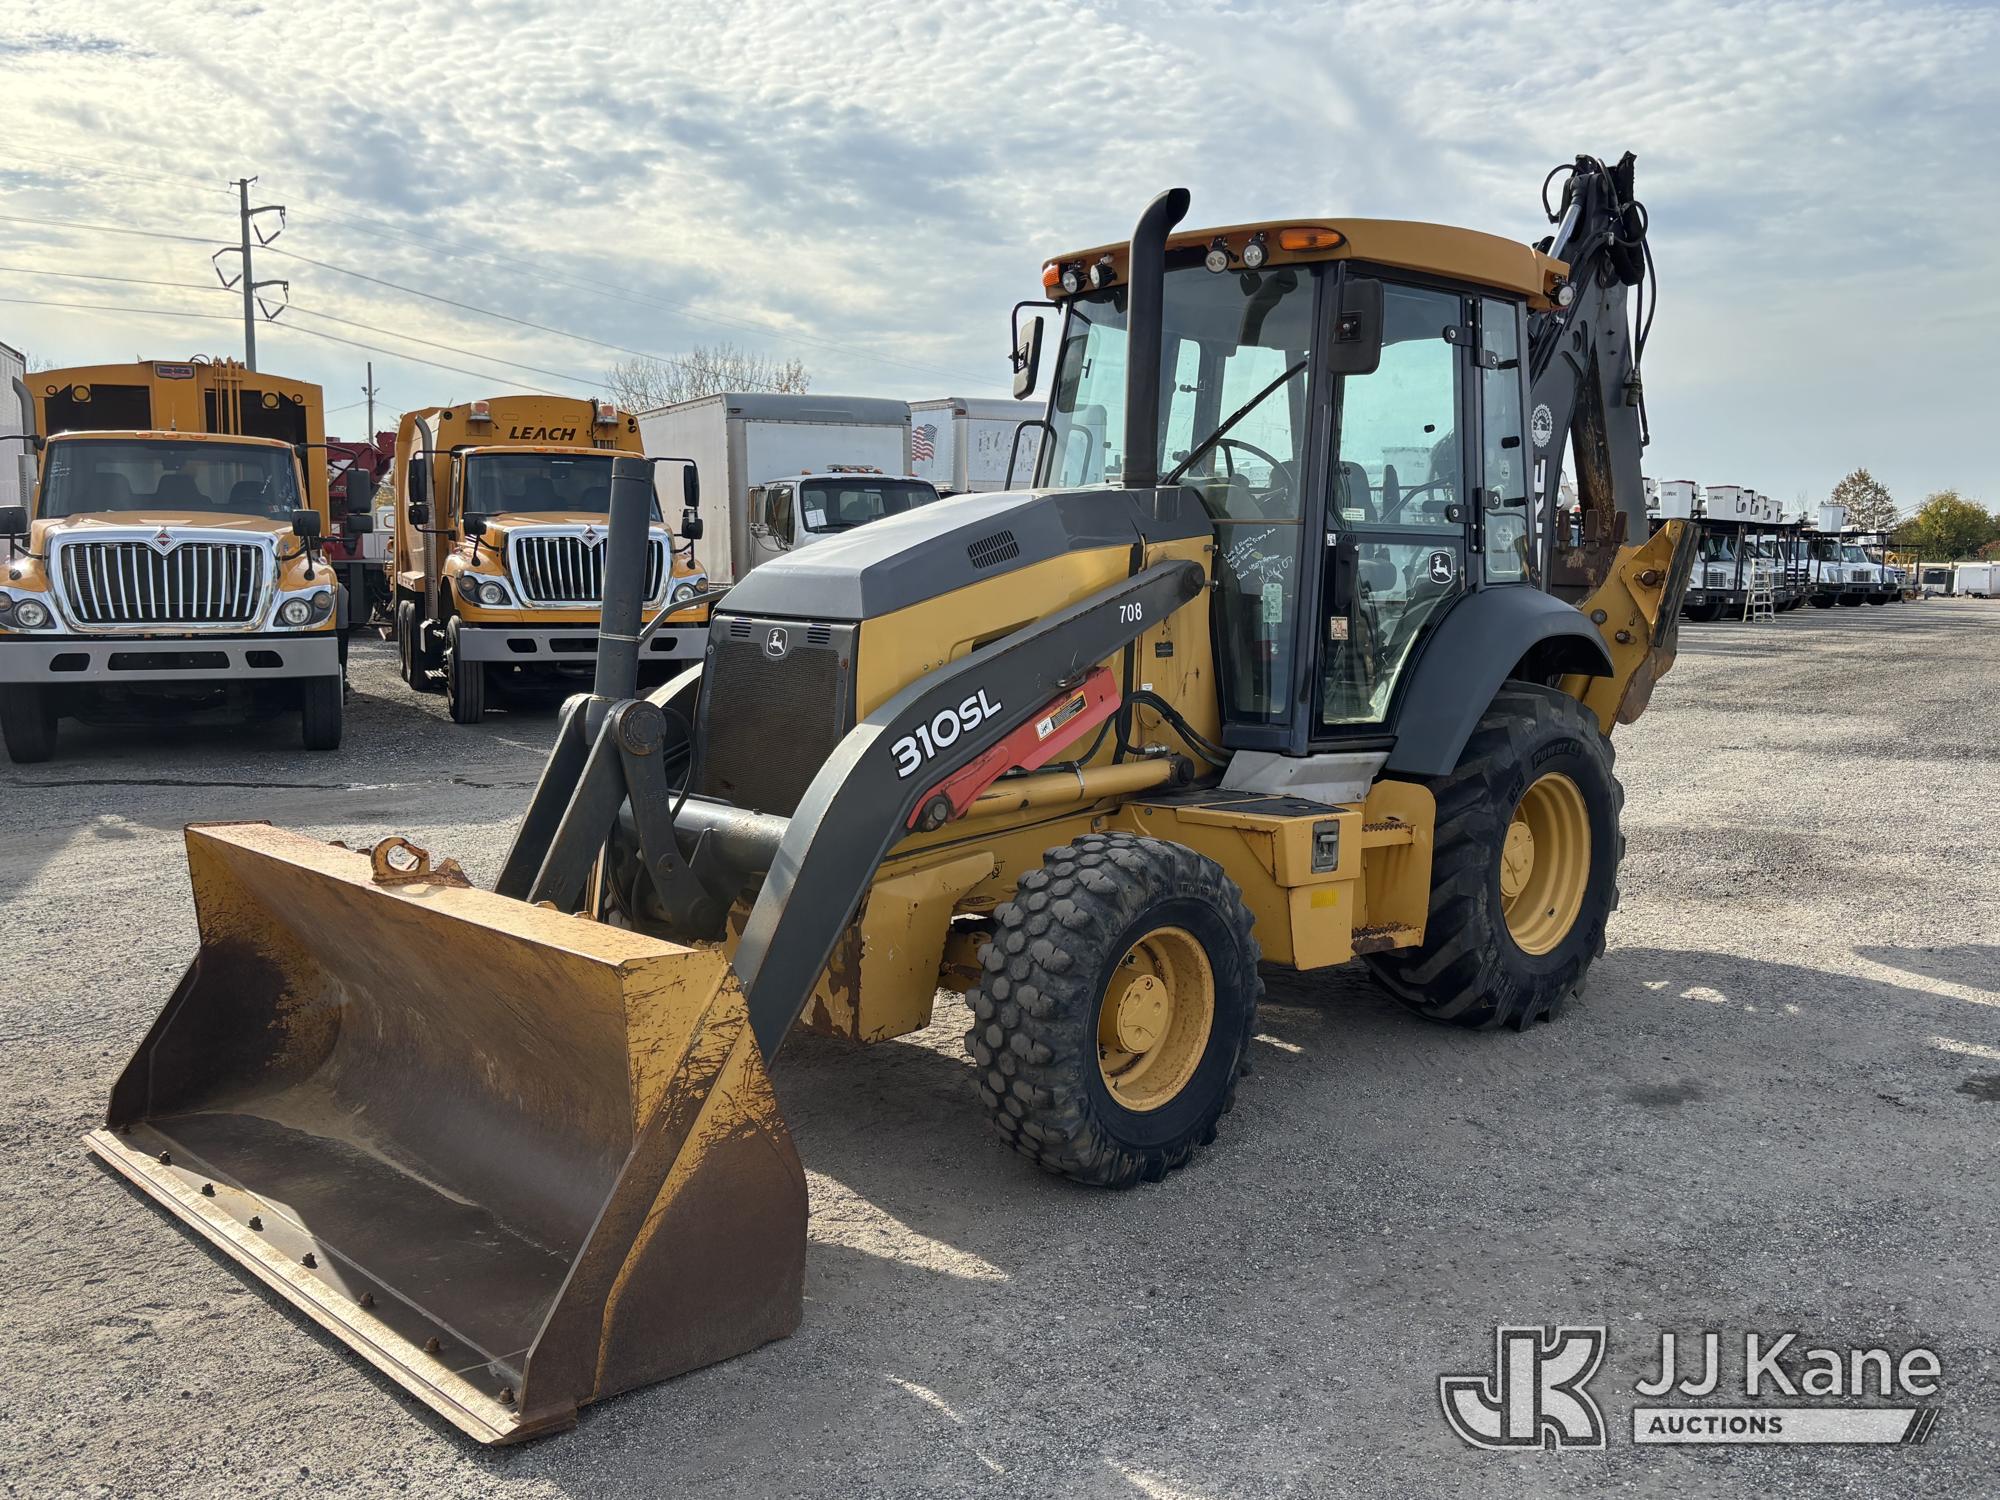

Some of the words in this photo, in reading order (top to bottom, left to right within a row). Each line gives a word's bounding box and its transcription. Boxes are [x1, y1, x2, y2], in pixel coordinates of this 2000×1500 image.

[510, 426, 577, 441] LEACH
[1119, 603, 1143, 624] 708
[891, 689, 1002, 778] 310SL
